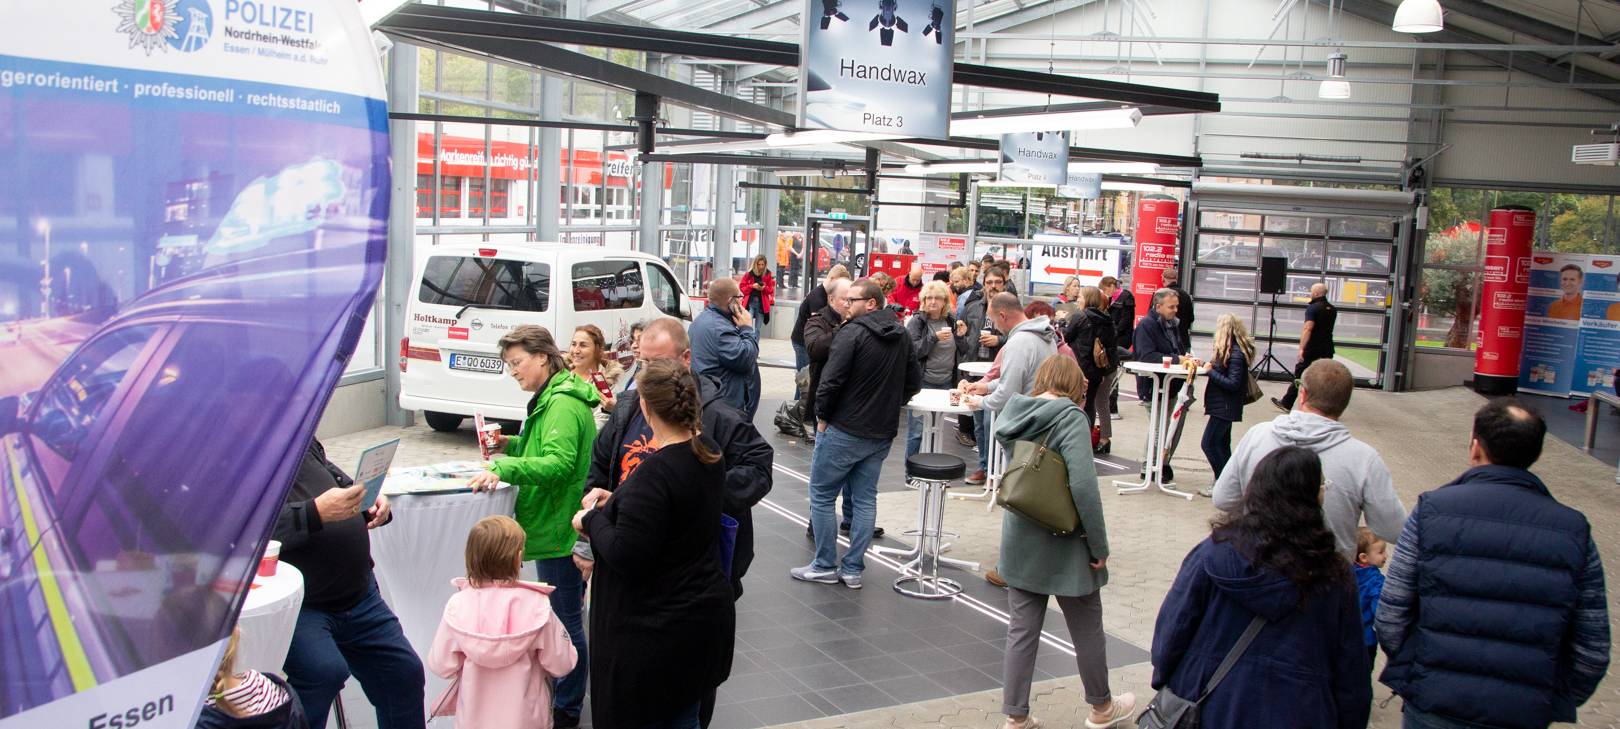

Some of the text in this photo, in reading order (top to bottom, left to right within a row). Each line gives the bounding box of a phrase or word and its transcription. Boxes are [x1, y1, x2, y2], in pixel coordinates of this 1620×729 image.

[225, 0, 314, 34] POLIZEI
[224, 26, 321, 50] Nordrhein-Westfal
[839, 58, 927, 86] Handwax
[0, 70, 341, 114] gerorientiert professionell rechtsstaatlich
[863, 112, 904, 128] Platz 3
[1018, 147, 1058, 160] Handwax
[1041, 244, 1108, 261] Ausfahrt
[414, 313, 458, 326] Holtkamp
[456, 356, 462, 366] E
[480, 359, 502, 370] 6039
[89, 694, 174, 729] Essen
